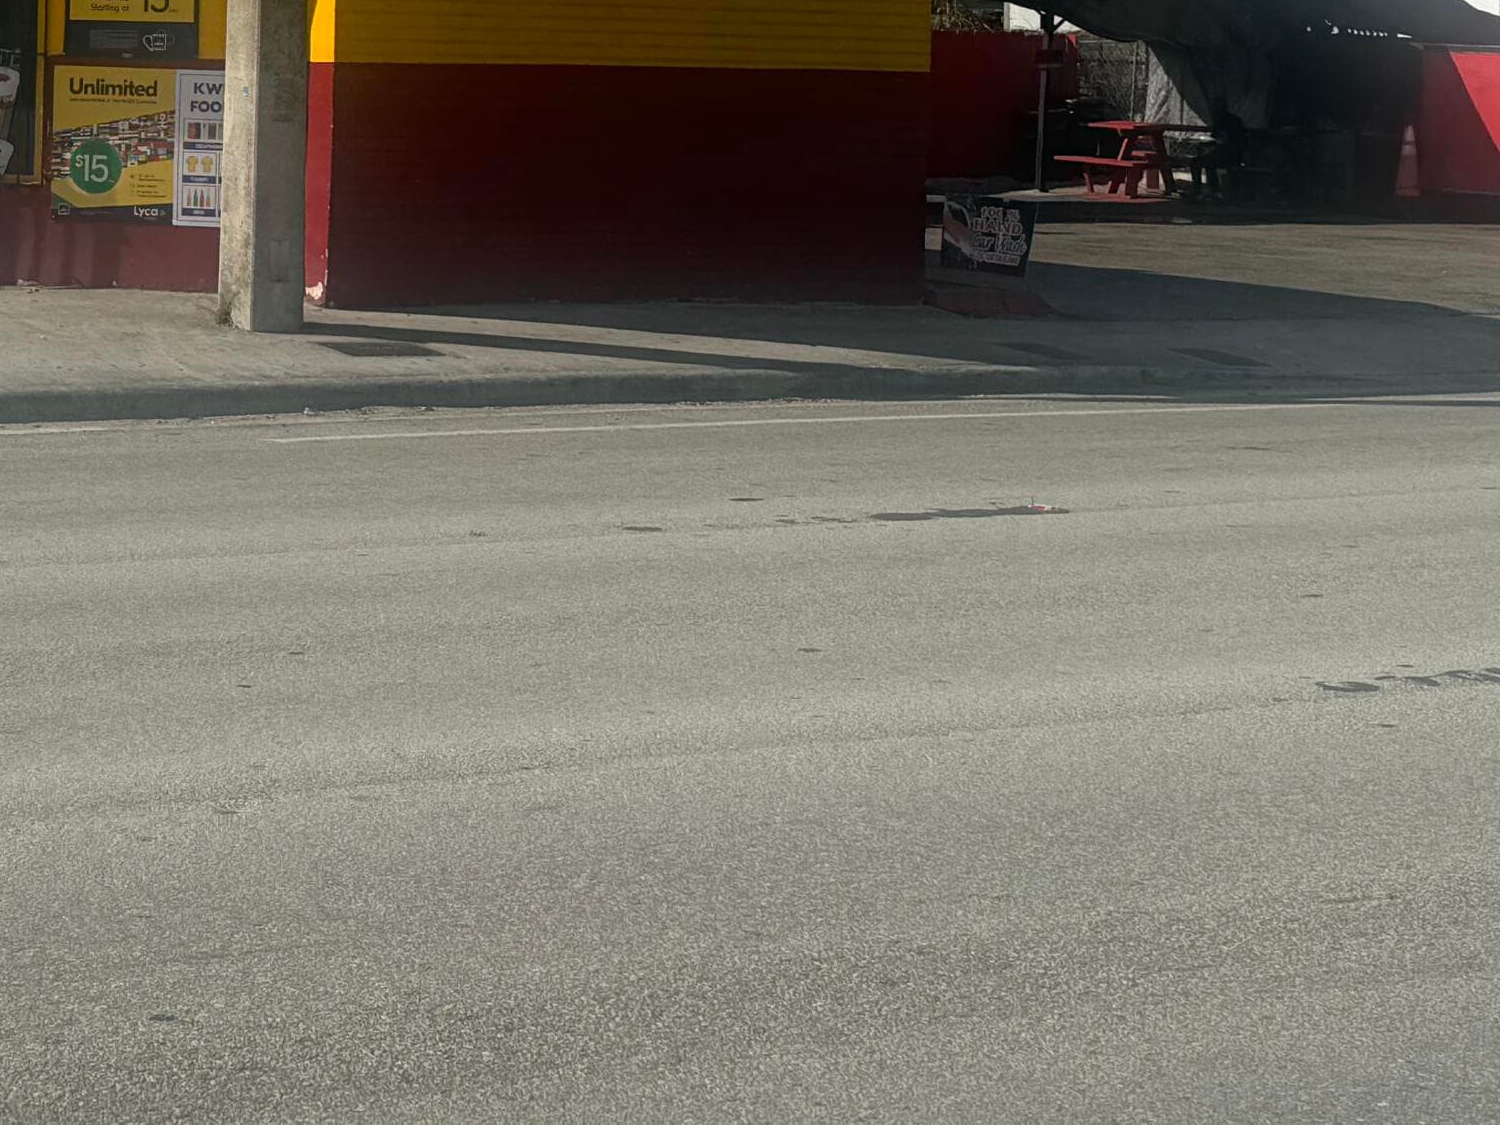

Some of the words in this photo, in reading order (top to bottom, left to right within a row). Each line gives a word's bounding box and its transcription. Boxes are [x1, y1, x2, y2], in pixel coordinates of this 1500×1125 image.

[69, 77, 158, 97] Unlimited
[76, 154, 109, 183] $15
[133, 206, 159, 218] Lyca
[973, 217, 1023, 236] HAND
